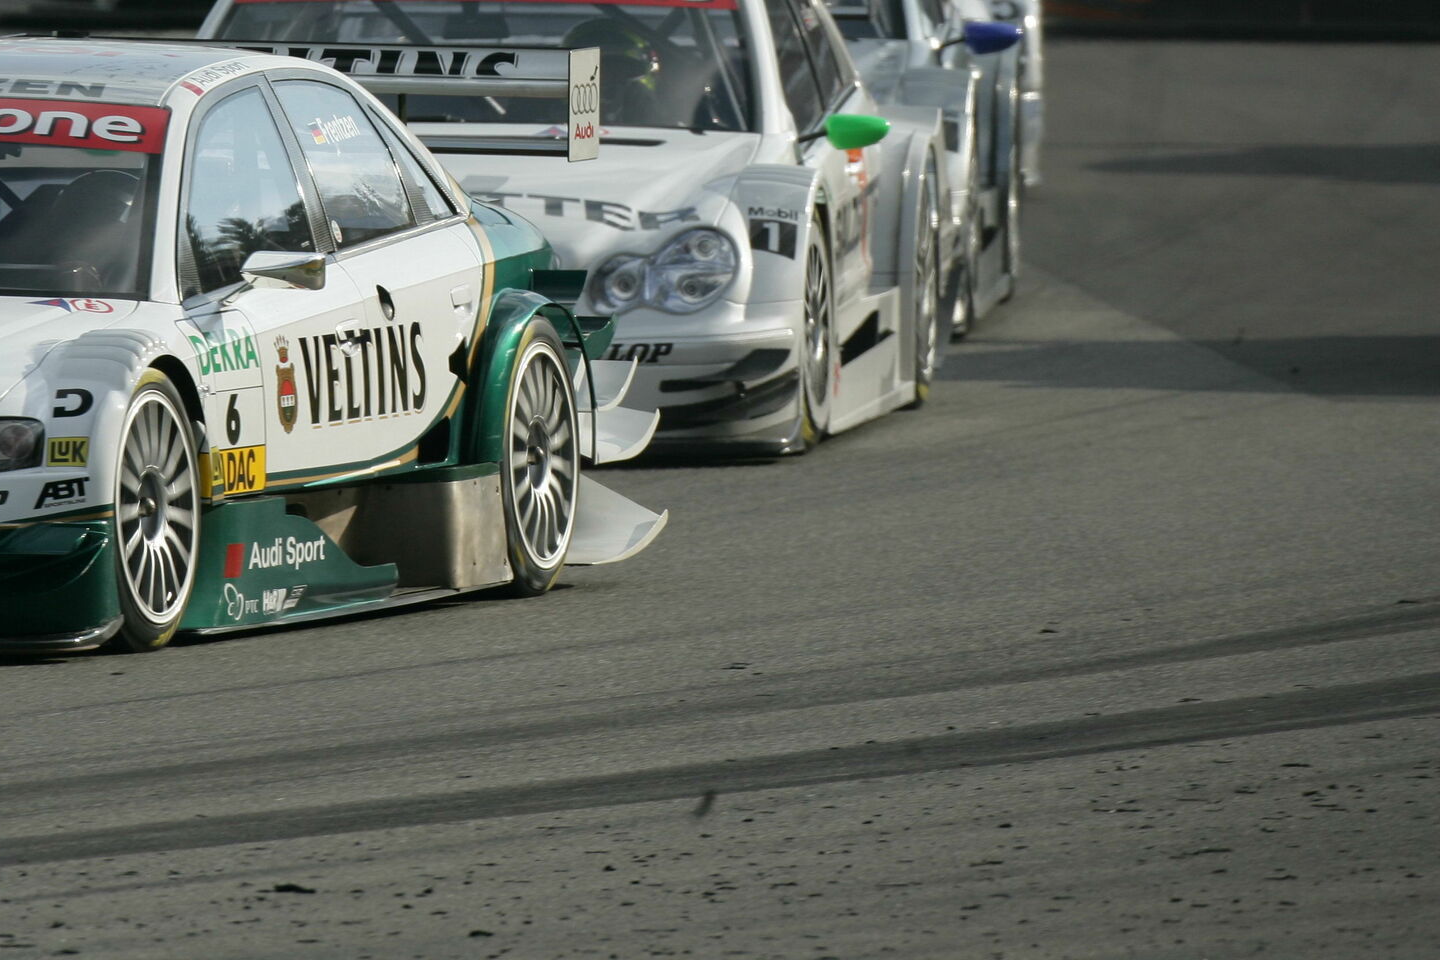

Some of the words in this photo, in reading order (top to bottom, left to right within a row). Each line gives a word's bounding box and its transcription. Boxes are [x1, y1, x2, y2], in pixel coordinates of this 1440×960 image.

[574, 123, 595, 140] Audi
[747, 206, 799, 221] Mobil
[188, 326, 260, 376] DEKRA
[298, 321, 427, 428] VELTINS
[225, 393, 241, 446] 6
[32, 476, 90, 510] ABT
[248, 537, 283, 570] Audi
[285, 535, 326, 571] Sport
